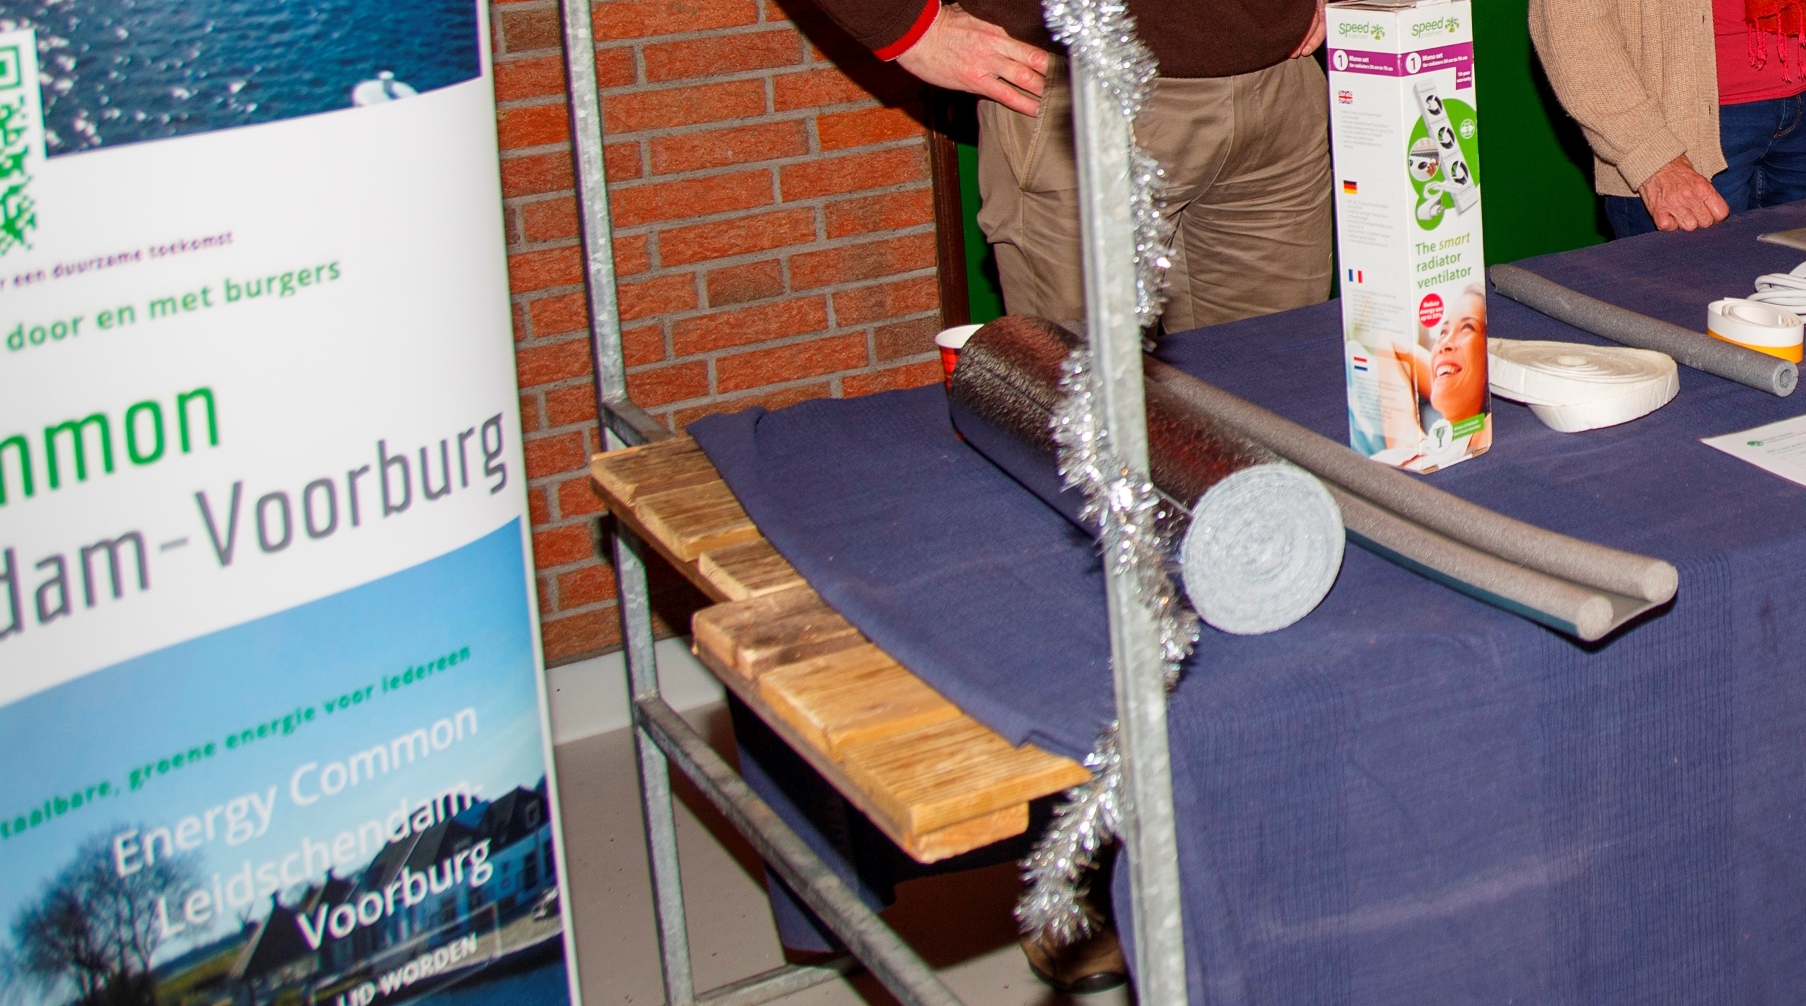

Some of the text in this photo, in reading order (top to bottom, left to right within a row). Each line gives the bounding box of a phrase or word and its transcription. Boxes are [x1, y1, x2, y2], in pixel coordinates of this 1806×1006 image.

[1338, 22, 1370, 38] speed
[1411, 16, 1444, 38] speed
[1337, 54, 1344, 68] 1
[1410, 57, 1416, 71] 1
[13, 268, 46, 287] een
[52, 250, 143, 279] duurzame
[150, 231, 234, 257] toekomst
[1415, 232, 1471, 256] The smart
[1416, 253, 1462, 273] radiator
[1417, 266, 1472, 289] ventilator
[6, 259, 342, 352] door en met burgers
[129, 742, 216, 789] groene
[225, 703, 315, 751] energie
[325, 683, 374, 714] voor
[382, 645, 470, 693] iedereen
[112, 706, 478, 879] Energy Common
[152, 779, 485, 942] Leidschendam-
[297, 838, 494, 950] Voorburg
[379, 932, 478, 996] WORDEN
